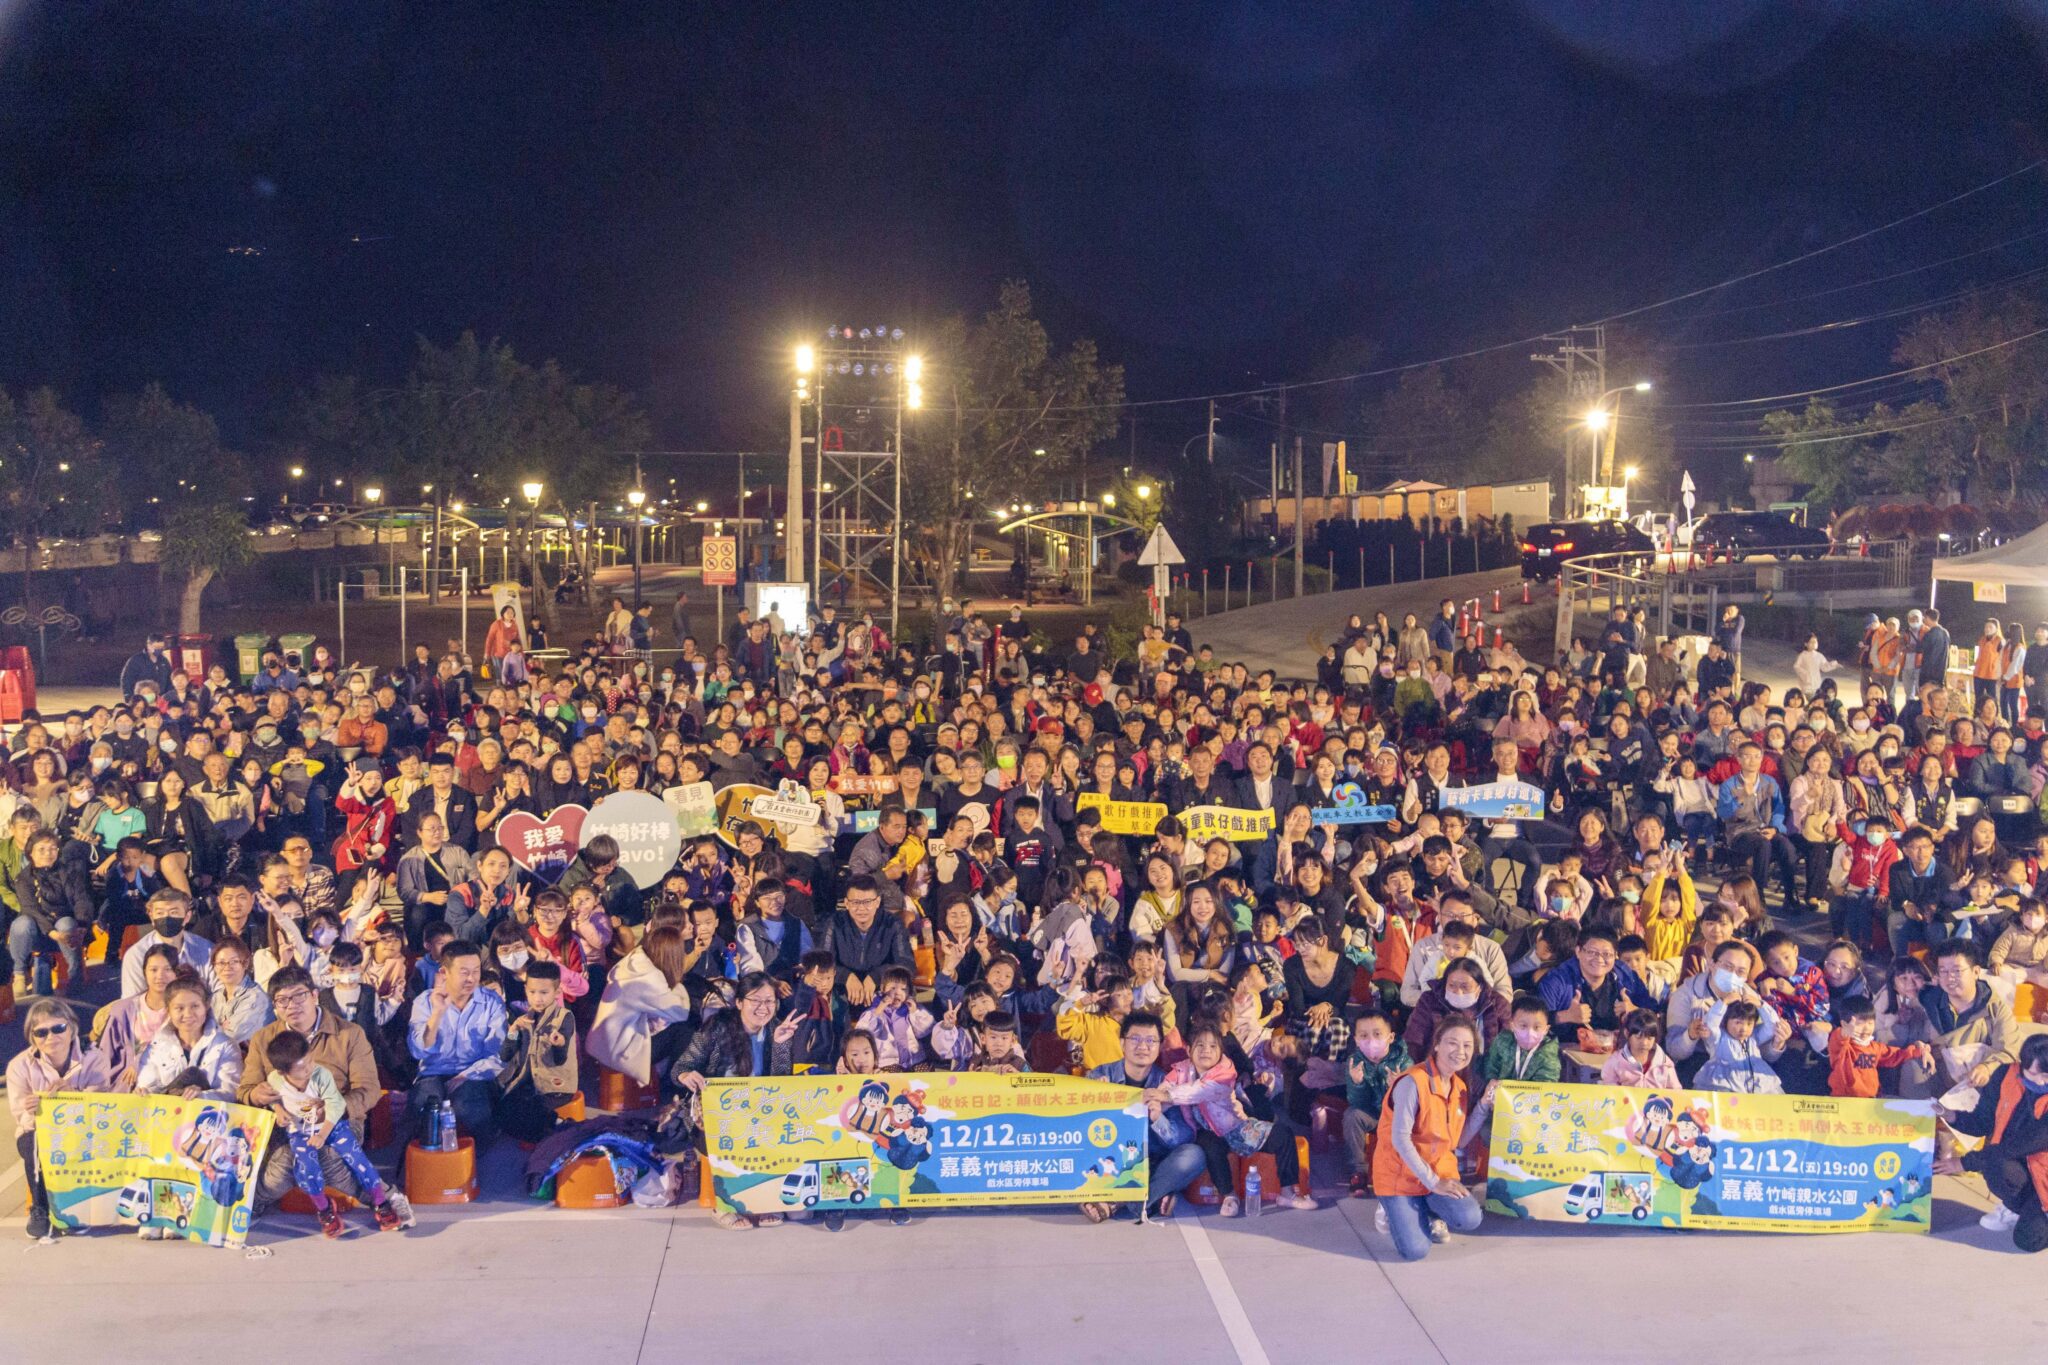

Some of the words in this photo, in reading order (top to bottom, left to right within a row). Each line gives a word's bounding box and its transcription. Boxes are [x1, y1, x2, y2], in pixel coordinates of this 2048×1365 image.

[674, 788, 704, 804] 看見
[523, 825, 565, 849] 我愛
[590, 822, 671, 843] 竹崎好棒
[527, 849, 568, 870] 竹崎
[618, 847, 665, 862] avo!
[940, 1123, 1015, 1148] 12/12
[1039, 1131, 1082, 1146] 19:00
[940, 1156, 982, 1178] 嘉義
[984, 1158, 1074, 1176] 竹崎親水公園
[1723, 1147, 1799, 1174] 12/12
[1823, 1161, 1868, 1177] 19:00
[1722, 1179, 1764, 1202] 嘉義
[1766, 1186, 1858, 1206] 竹崎親水公園
